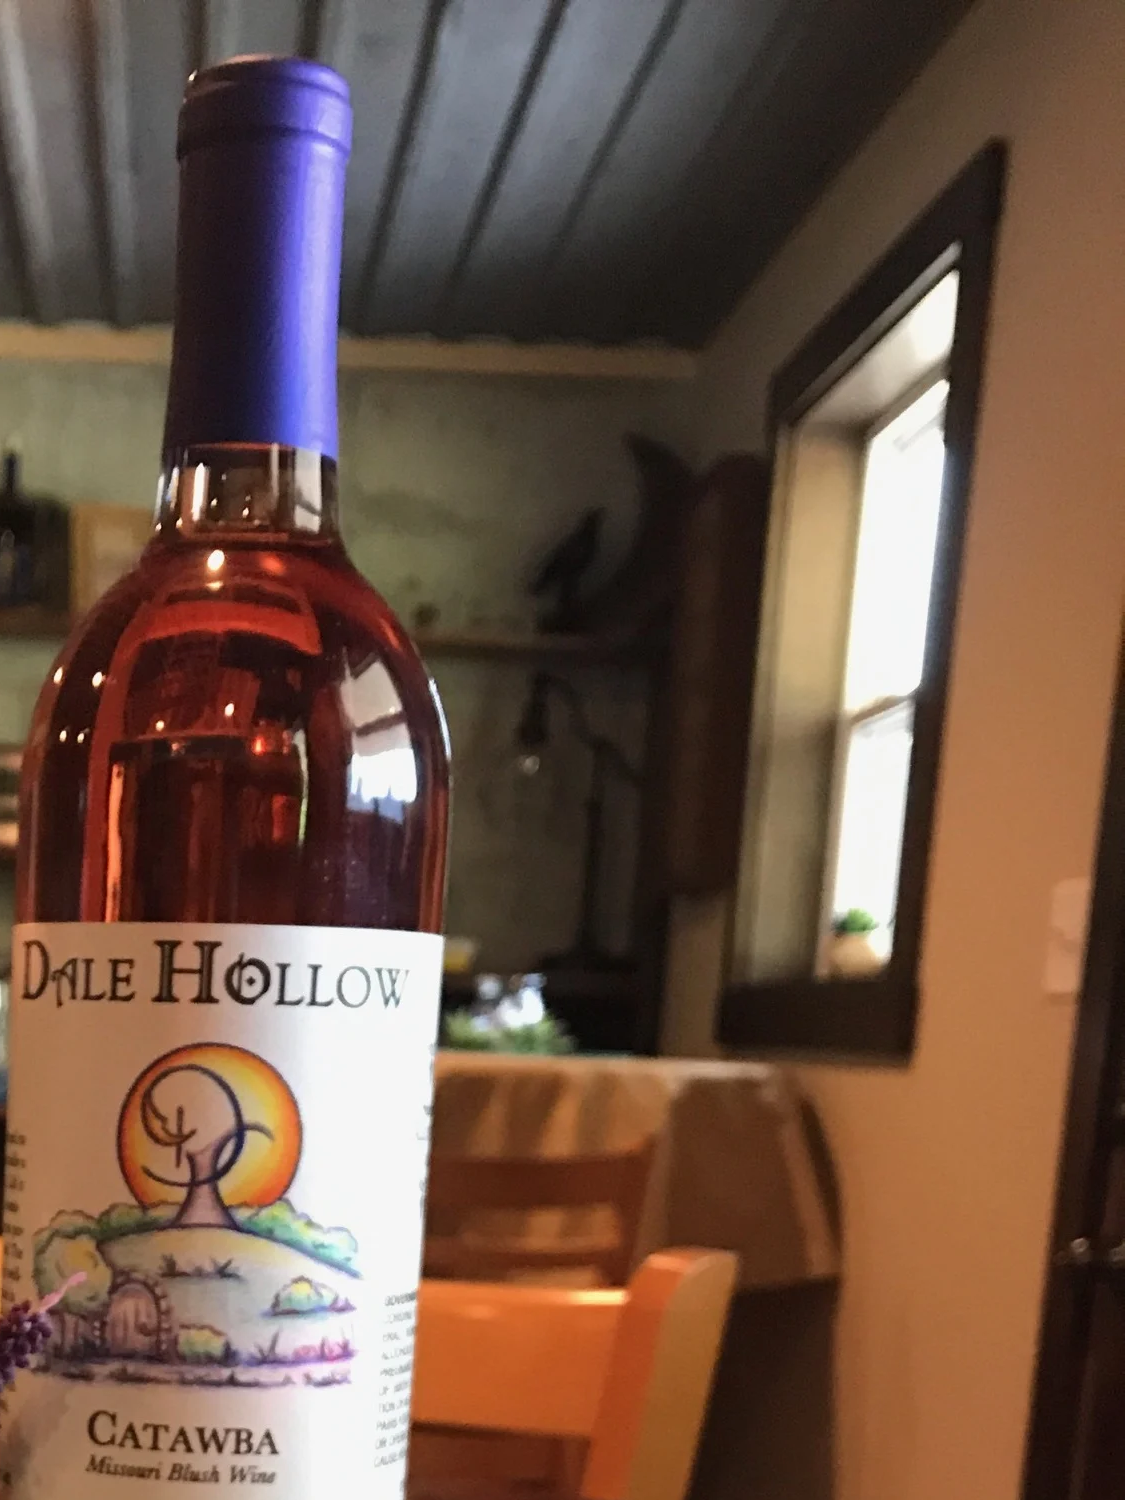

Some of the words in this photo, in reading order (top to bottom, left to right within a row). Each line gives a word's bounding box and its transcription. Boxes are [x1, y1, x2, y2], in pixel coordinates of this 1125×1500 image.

[87, 1409, 279, 1456] CATAWBA
[85, 1453, 161, 1480] Missouri
[167, 1461, 220, 1483] Blush
[230, 1463, 277, 1484] Wine
